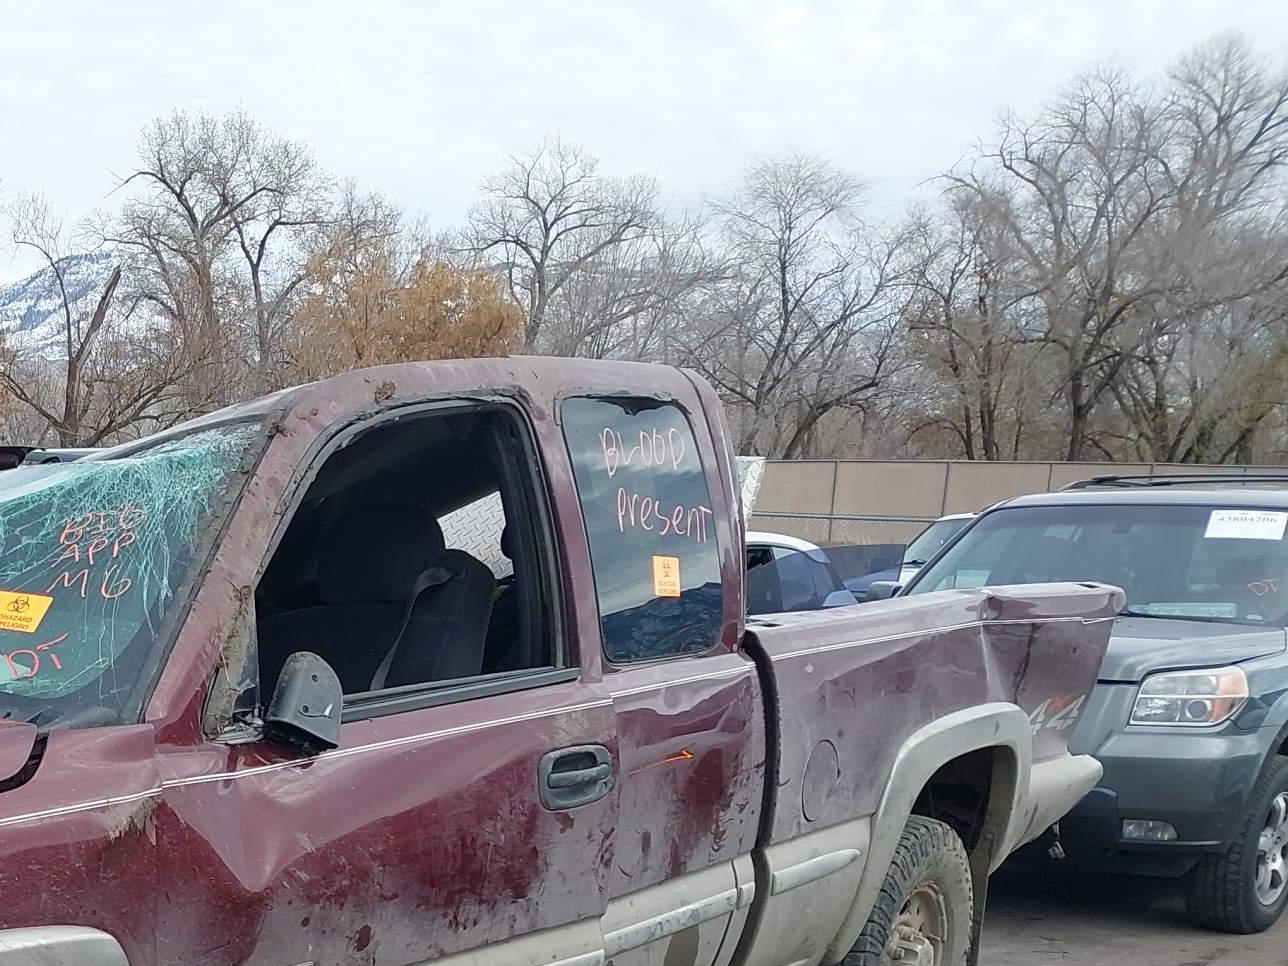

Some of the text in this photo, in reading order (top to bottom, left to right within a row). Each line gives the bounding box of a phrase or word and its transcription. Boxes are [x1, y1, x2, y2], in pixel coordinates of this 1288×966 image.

[598, 427, 685, 479] BLOOD
[50, 531, 136, 568] APP
[3, 632, 69, 678] DT
